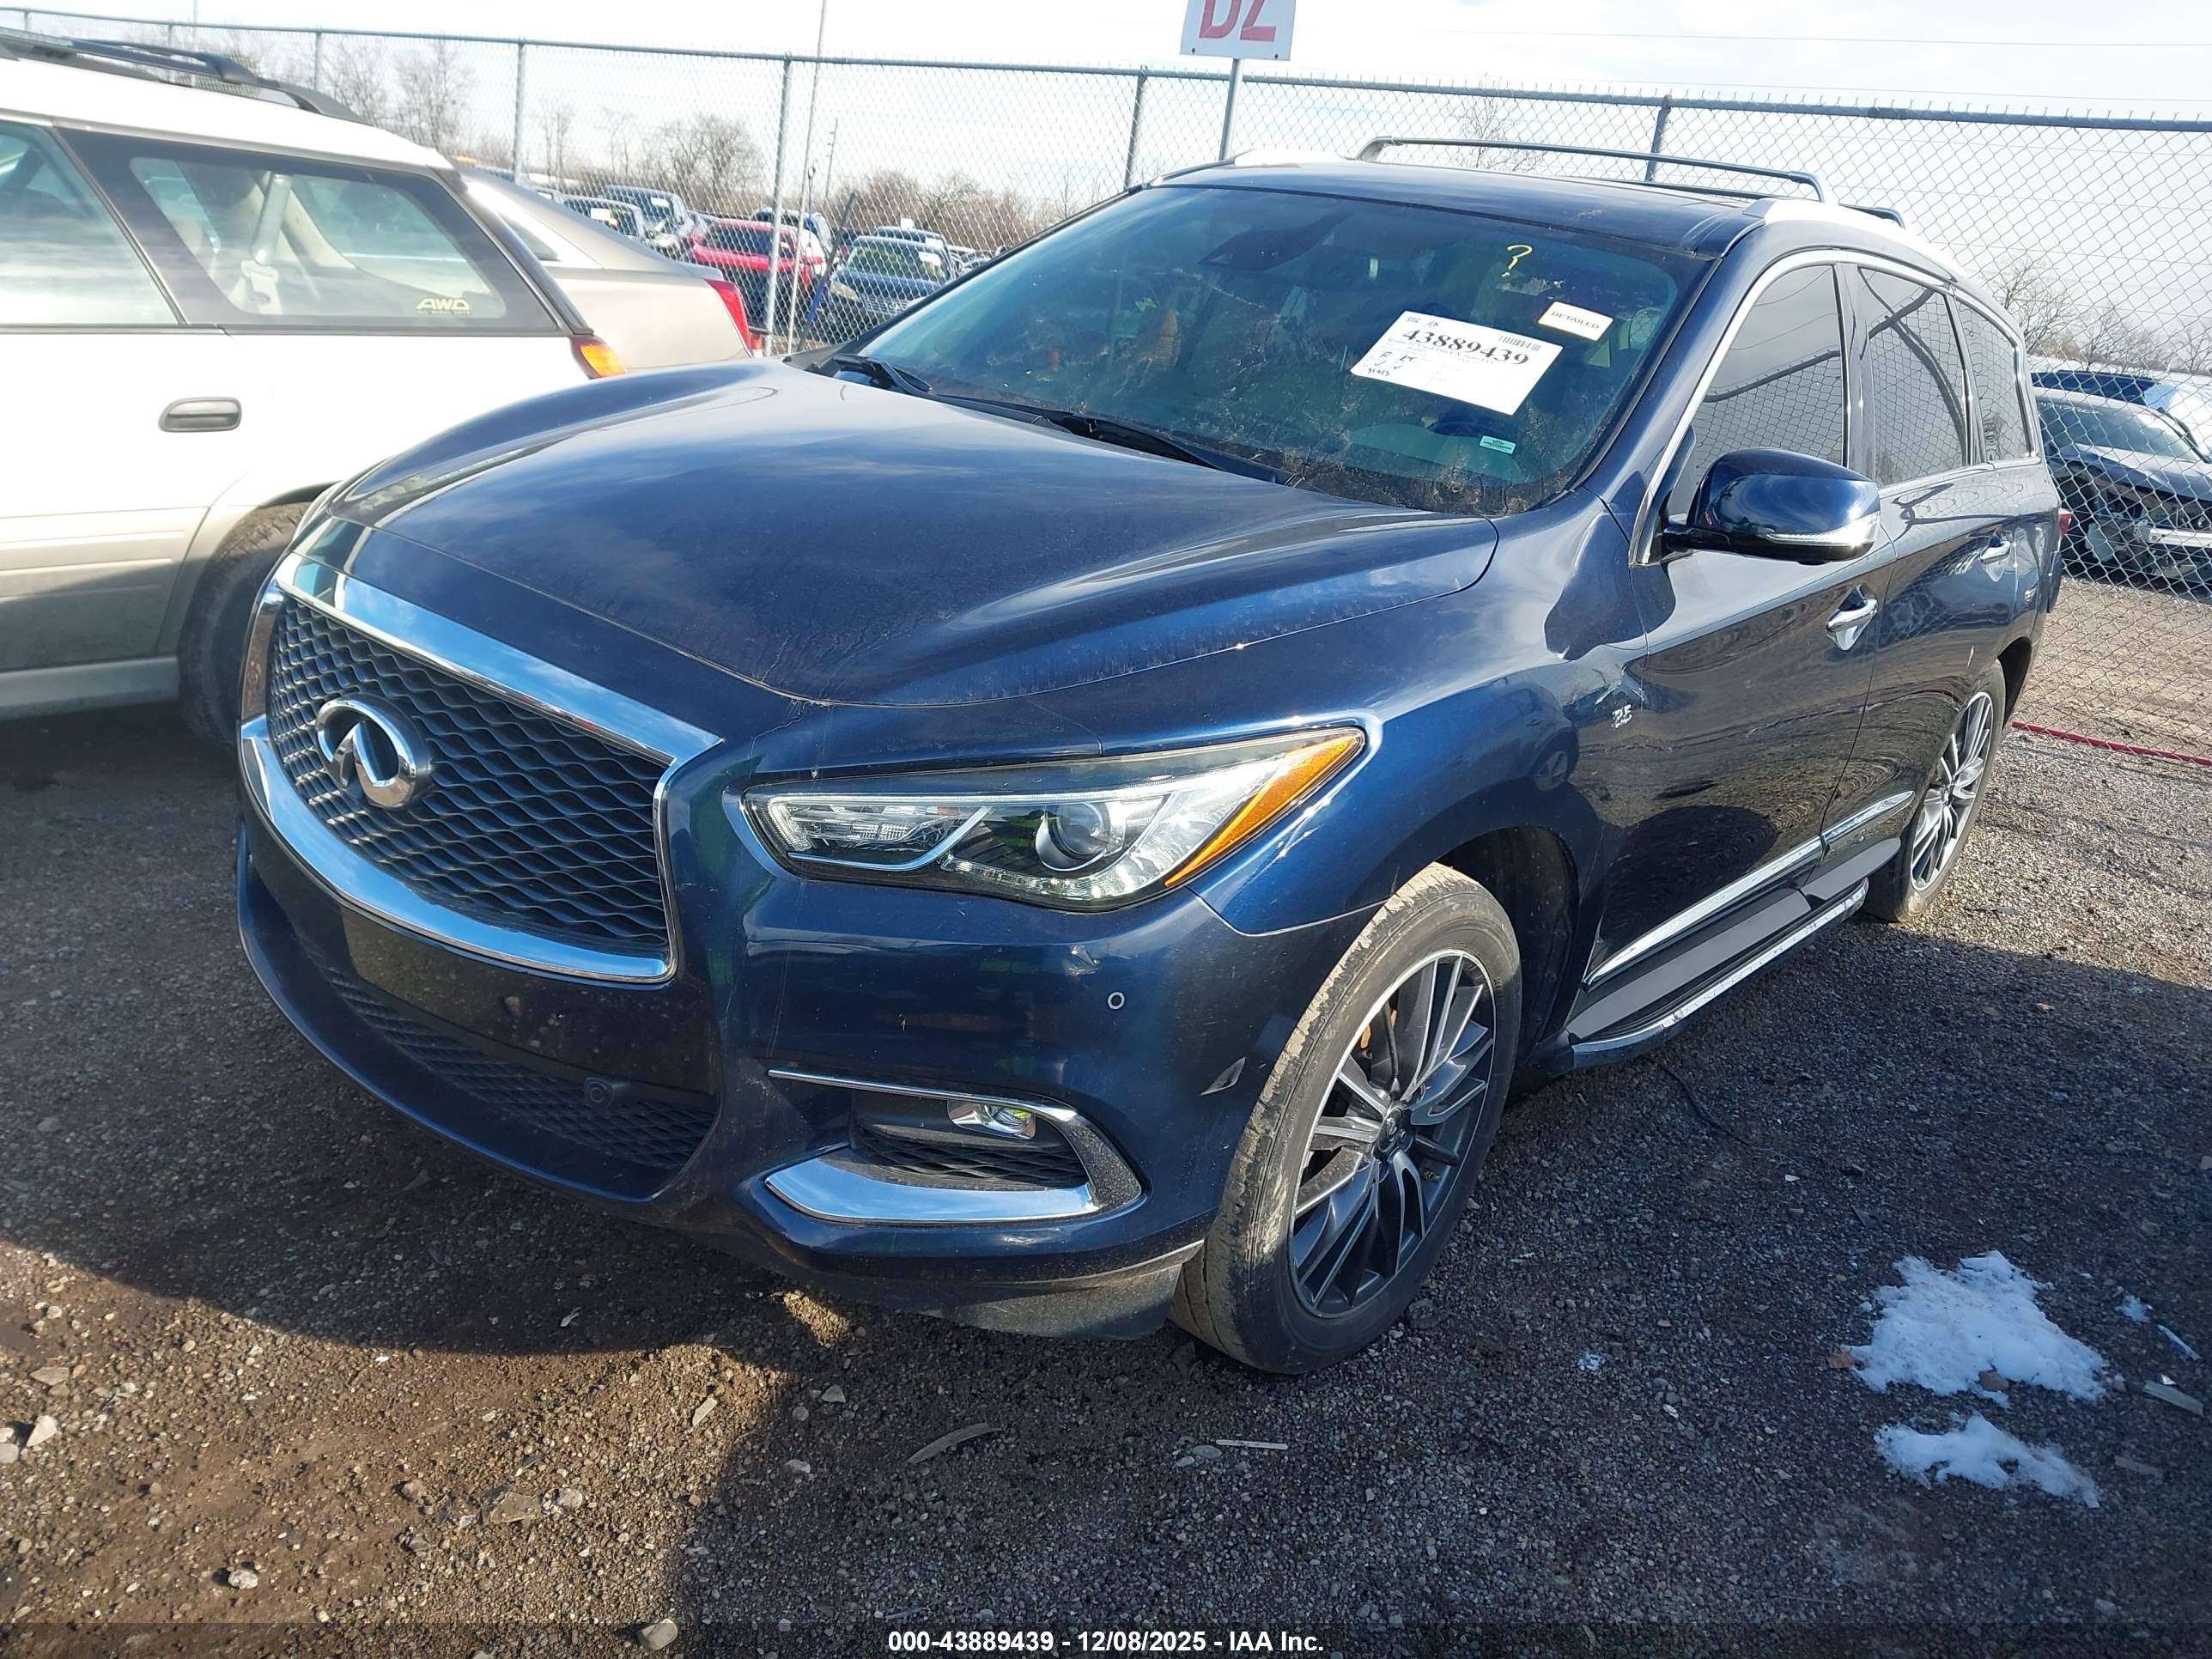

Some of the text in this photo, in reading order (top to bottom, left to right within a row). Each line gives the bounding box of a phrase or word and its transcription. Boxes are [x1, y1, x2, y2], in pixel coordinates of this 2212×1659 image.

[416, 297, 471, 310] AWD
[1551, 311, 1600, 329] DETAILED
[1402, 329, 1529, 365] 43889439
